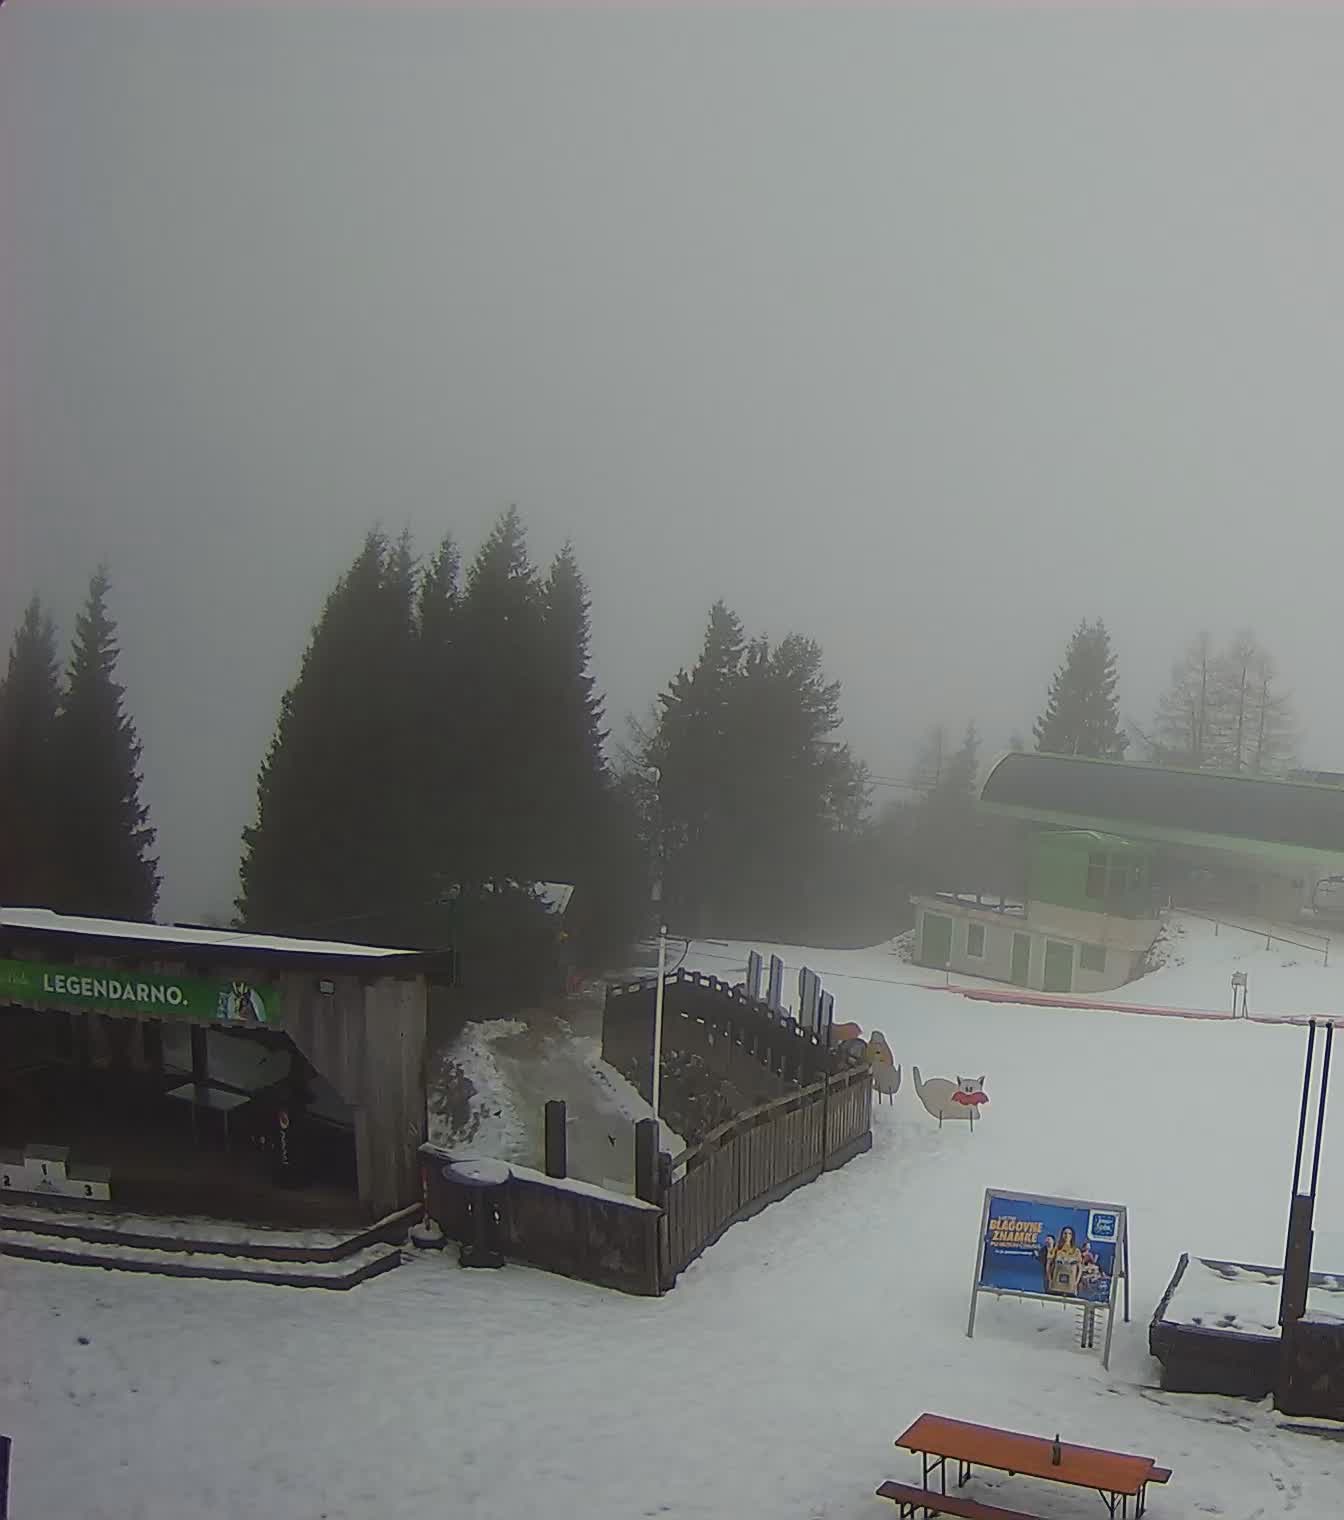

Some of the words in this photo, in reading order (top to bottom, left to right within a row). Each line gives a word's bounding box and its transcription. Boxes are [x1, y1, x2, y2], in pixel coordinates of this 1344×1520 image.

[43, 973, 189, 1006] LEGENDARNO.
[83, 1184, 93, 1196] 3
[992, 1230, 1039, 1243] ZNAMKE
